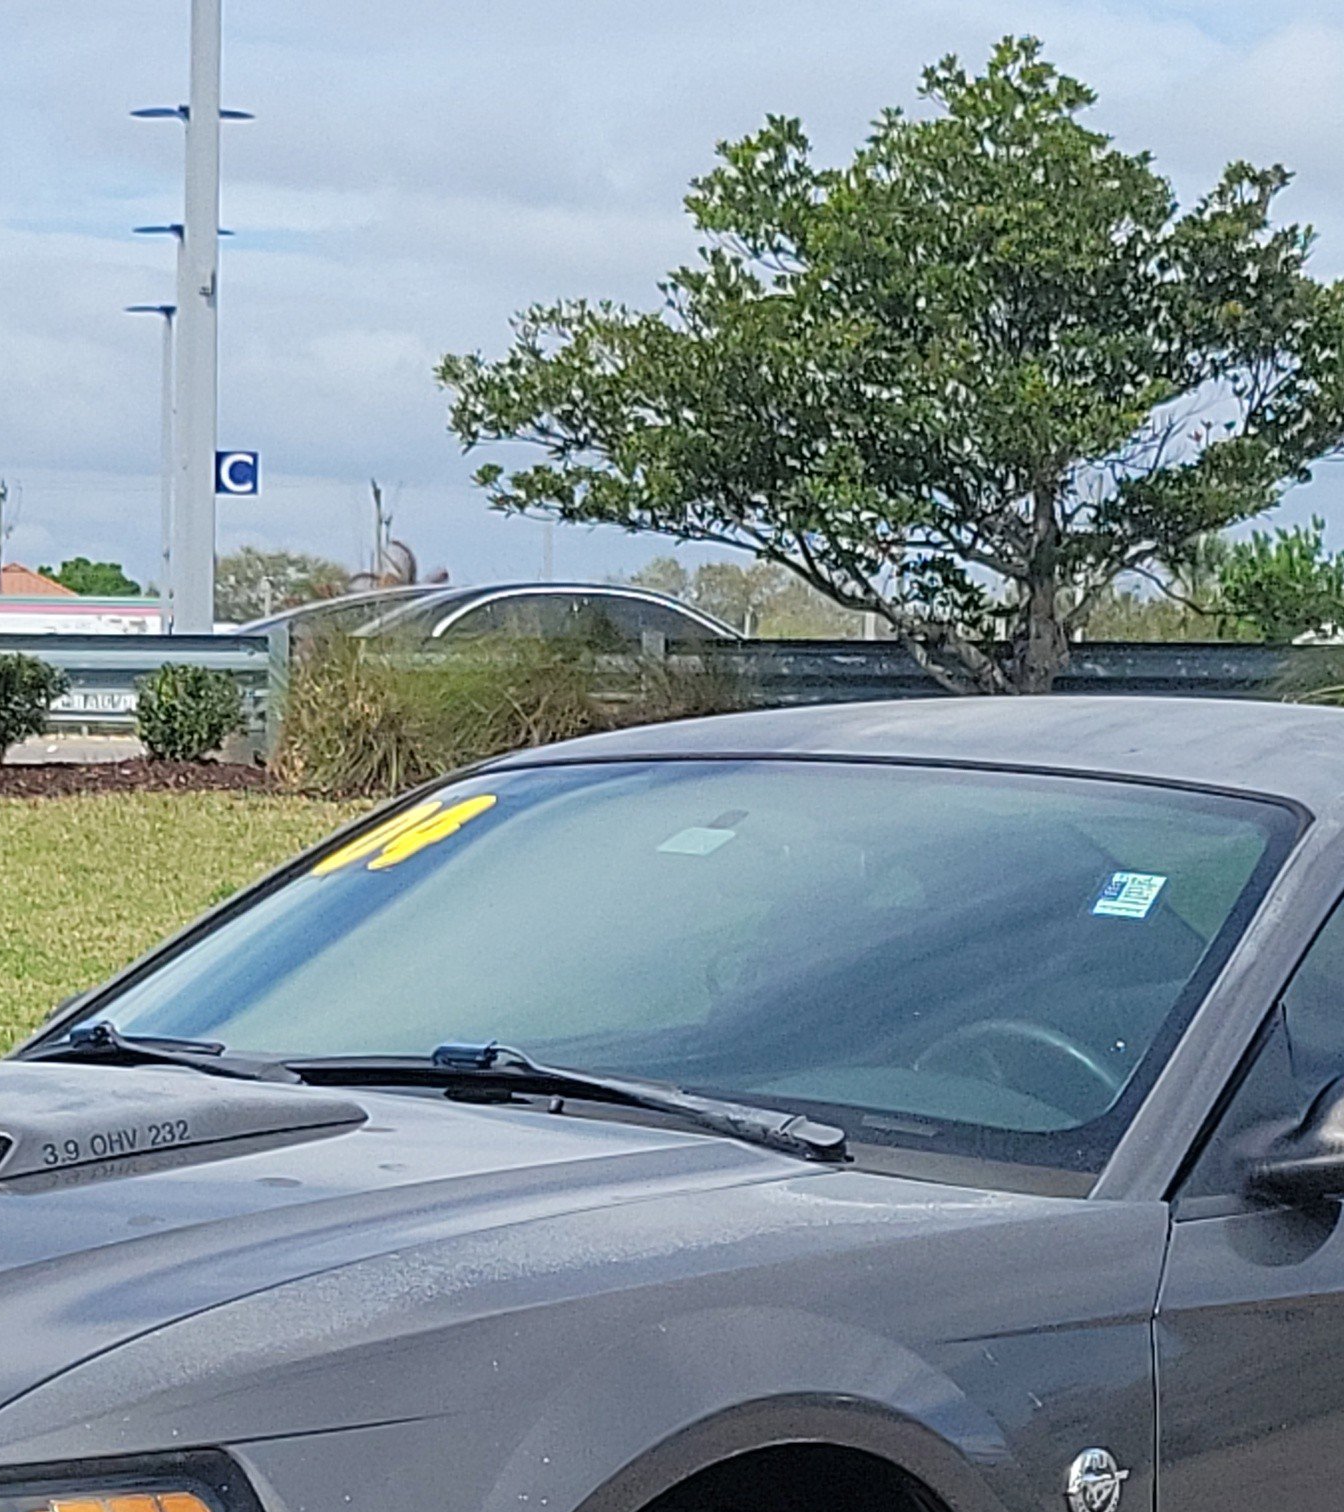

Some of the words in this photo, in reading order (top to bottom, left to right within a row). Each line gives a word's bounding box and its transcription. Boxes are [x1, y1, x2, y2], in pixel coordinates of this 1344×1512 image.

[219, 453, 254, 492] C
[43, 1139, 80, 1165] 3.9
[90, 1128, 138, 1156] OHV
[147, 1119, 191, 1146] 232
